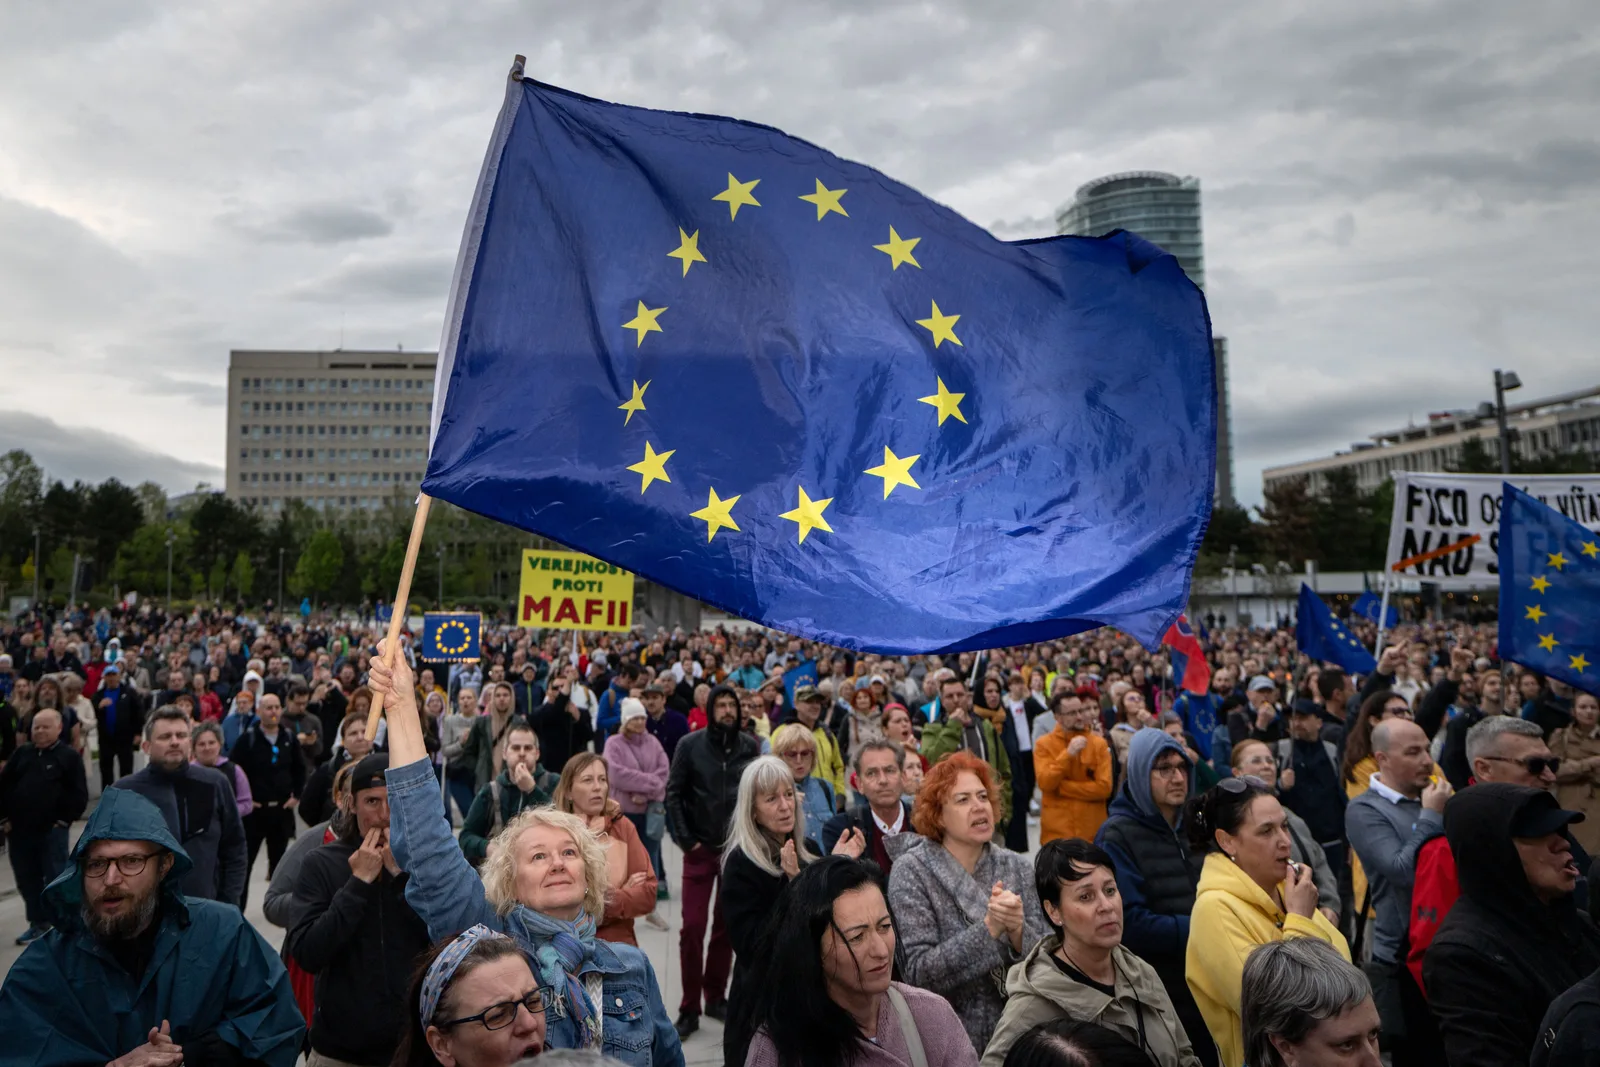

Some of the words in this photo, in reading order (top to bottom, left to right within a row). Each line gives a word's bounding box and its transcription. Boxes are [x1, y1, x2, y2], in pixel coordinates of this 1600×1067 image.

[1406, 484, 1468, 527] FICO
[552, 578, 603, 593] PROTI
[522, 594, 628, 627] MAFII
